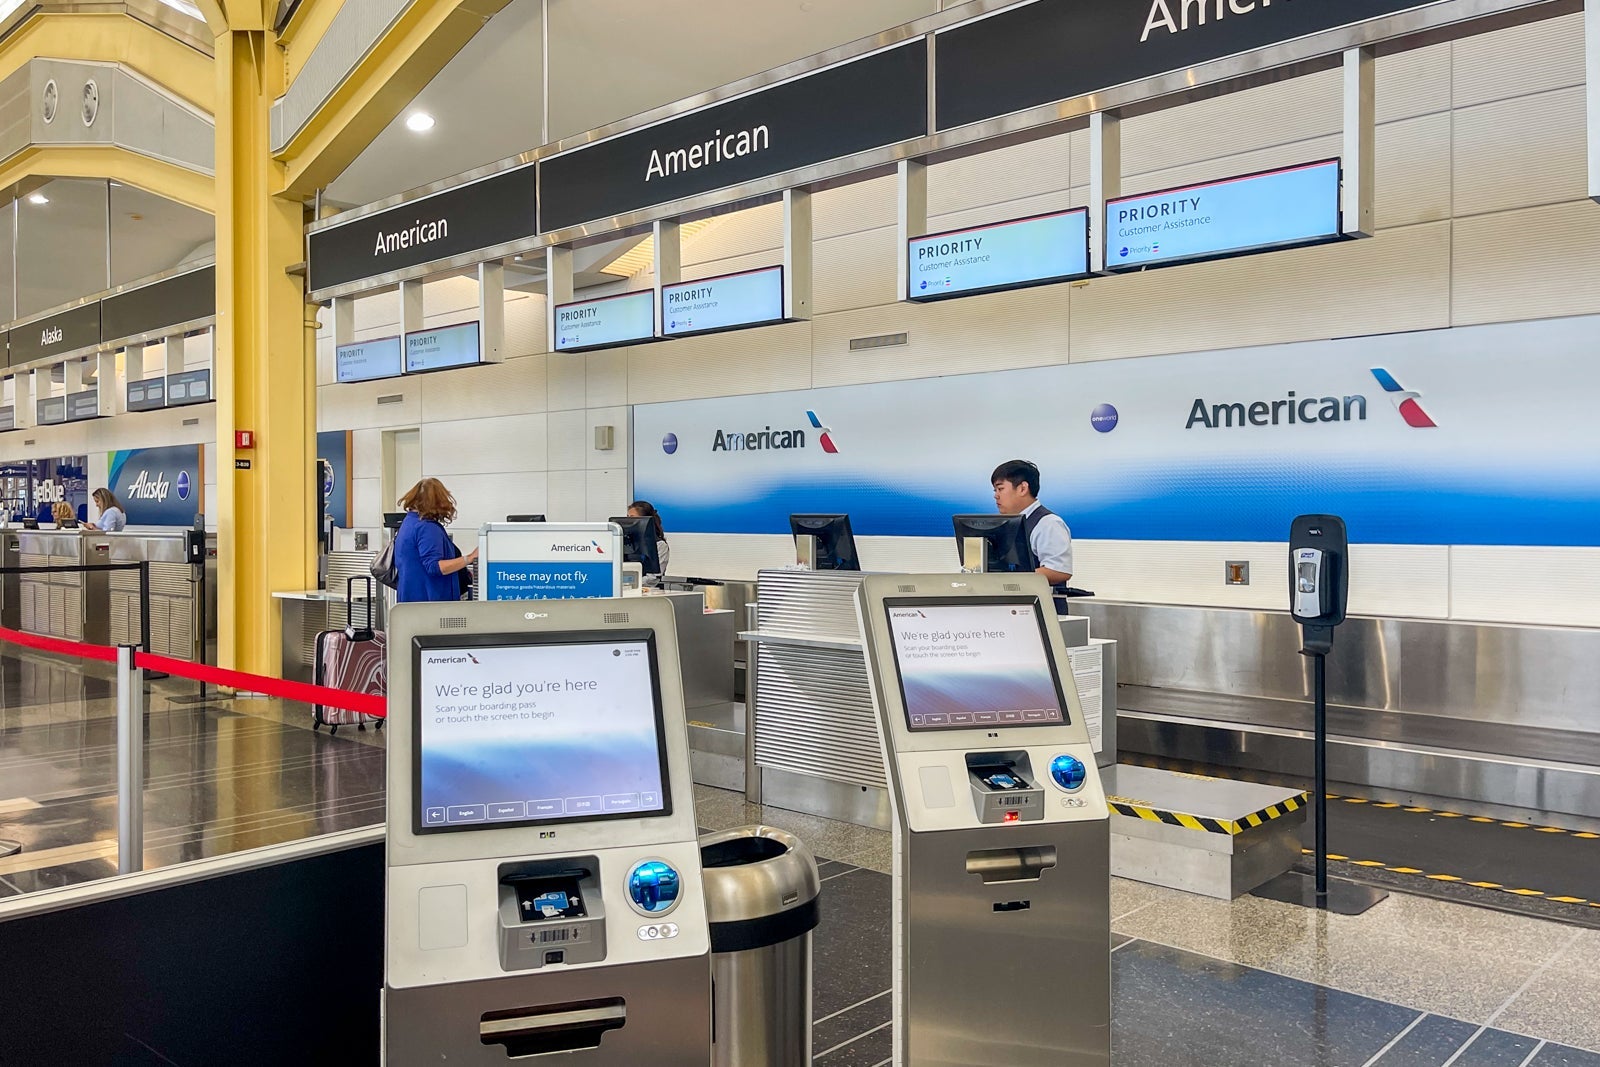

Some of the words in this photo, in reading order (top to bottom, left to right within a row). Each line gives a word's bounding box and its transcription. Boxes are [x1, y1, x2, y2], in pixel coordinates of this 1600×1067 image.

[645, 124, 769, 181] American
[1119, 197, 1200, 223] PRIORITY
[1119, 224, 1161, 238] Customer
[1164, 215, 1211, 230] Assistance
[374, 217, 449, 256] American
[919, 238, 982, 259] PRIORITY
[919, 261, 952, 272] Customer
[954, 254, 990, 266] Assistance
[669, 287, 713, 303] PRIORITY
[561, 307, 597, 321] PRIORITY
[41, 326, 62, 346] Alaska
[409, 335, 437, 347] PRIORITY
[340, 348, 365, 358] PRIORITY
[1185, 391, 1367, 429] American
[712, 426, 805, 451] American
[128, 470, 169, 503] Alaska
[551, 544, 591, 552] American
[497, 571, 527, 581] These
[529, 573, 552, 584] may
[554, 572, 572, 581] not
[574, 570, 588, 584] fly.
[901, 631, 929, 640] We're
[932, 630, 951, 642] glad
[953, 630, 982, 642] you're
[984, 630, 1005, 639] here
[427, 656, 467, 664] American
[435, 684, 478, 697] We're
[482, 682, 512, 699] glad
[516, 680, 561, 698] you're
[565, 679, 598, 691] here
[435, 704, 456, 713] Scan
[458, 704, 477, 713] your
[480, 702, 517, 711] boarding
[518, 702, 537, 710] pass
[447, 714, 472, 723] touch
[490, 713, 519, 721] screen
[531, 711, 555, 720] begin
